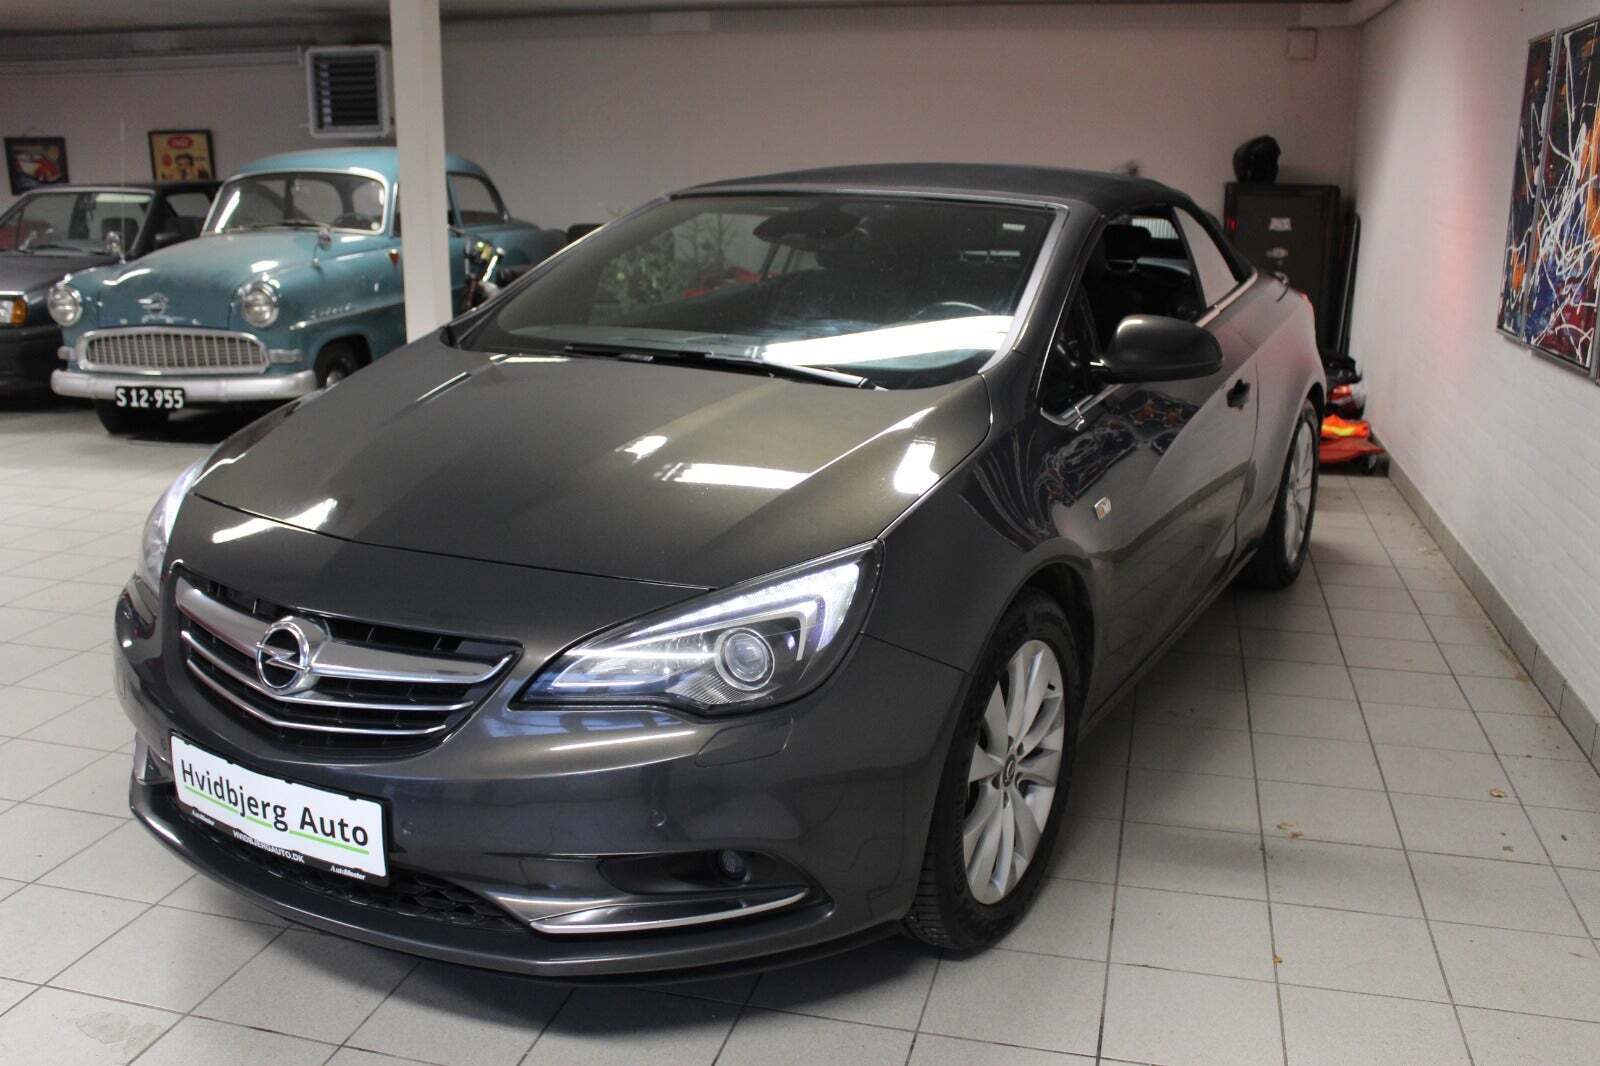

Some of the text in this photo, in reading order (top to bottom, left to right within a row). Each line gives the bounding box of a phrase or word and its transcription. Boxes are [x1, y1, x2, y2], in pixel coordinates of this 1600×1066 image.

[115, 388, 128, 408] S
[180, 758, 369, 847] Hvidbjerg Auto
